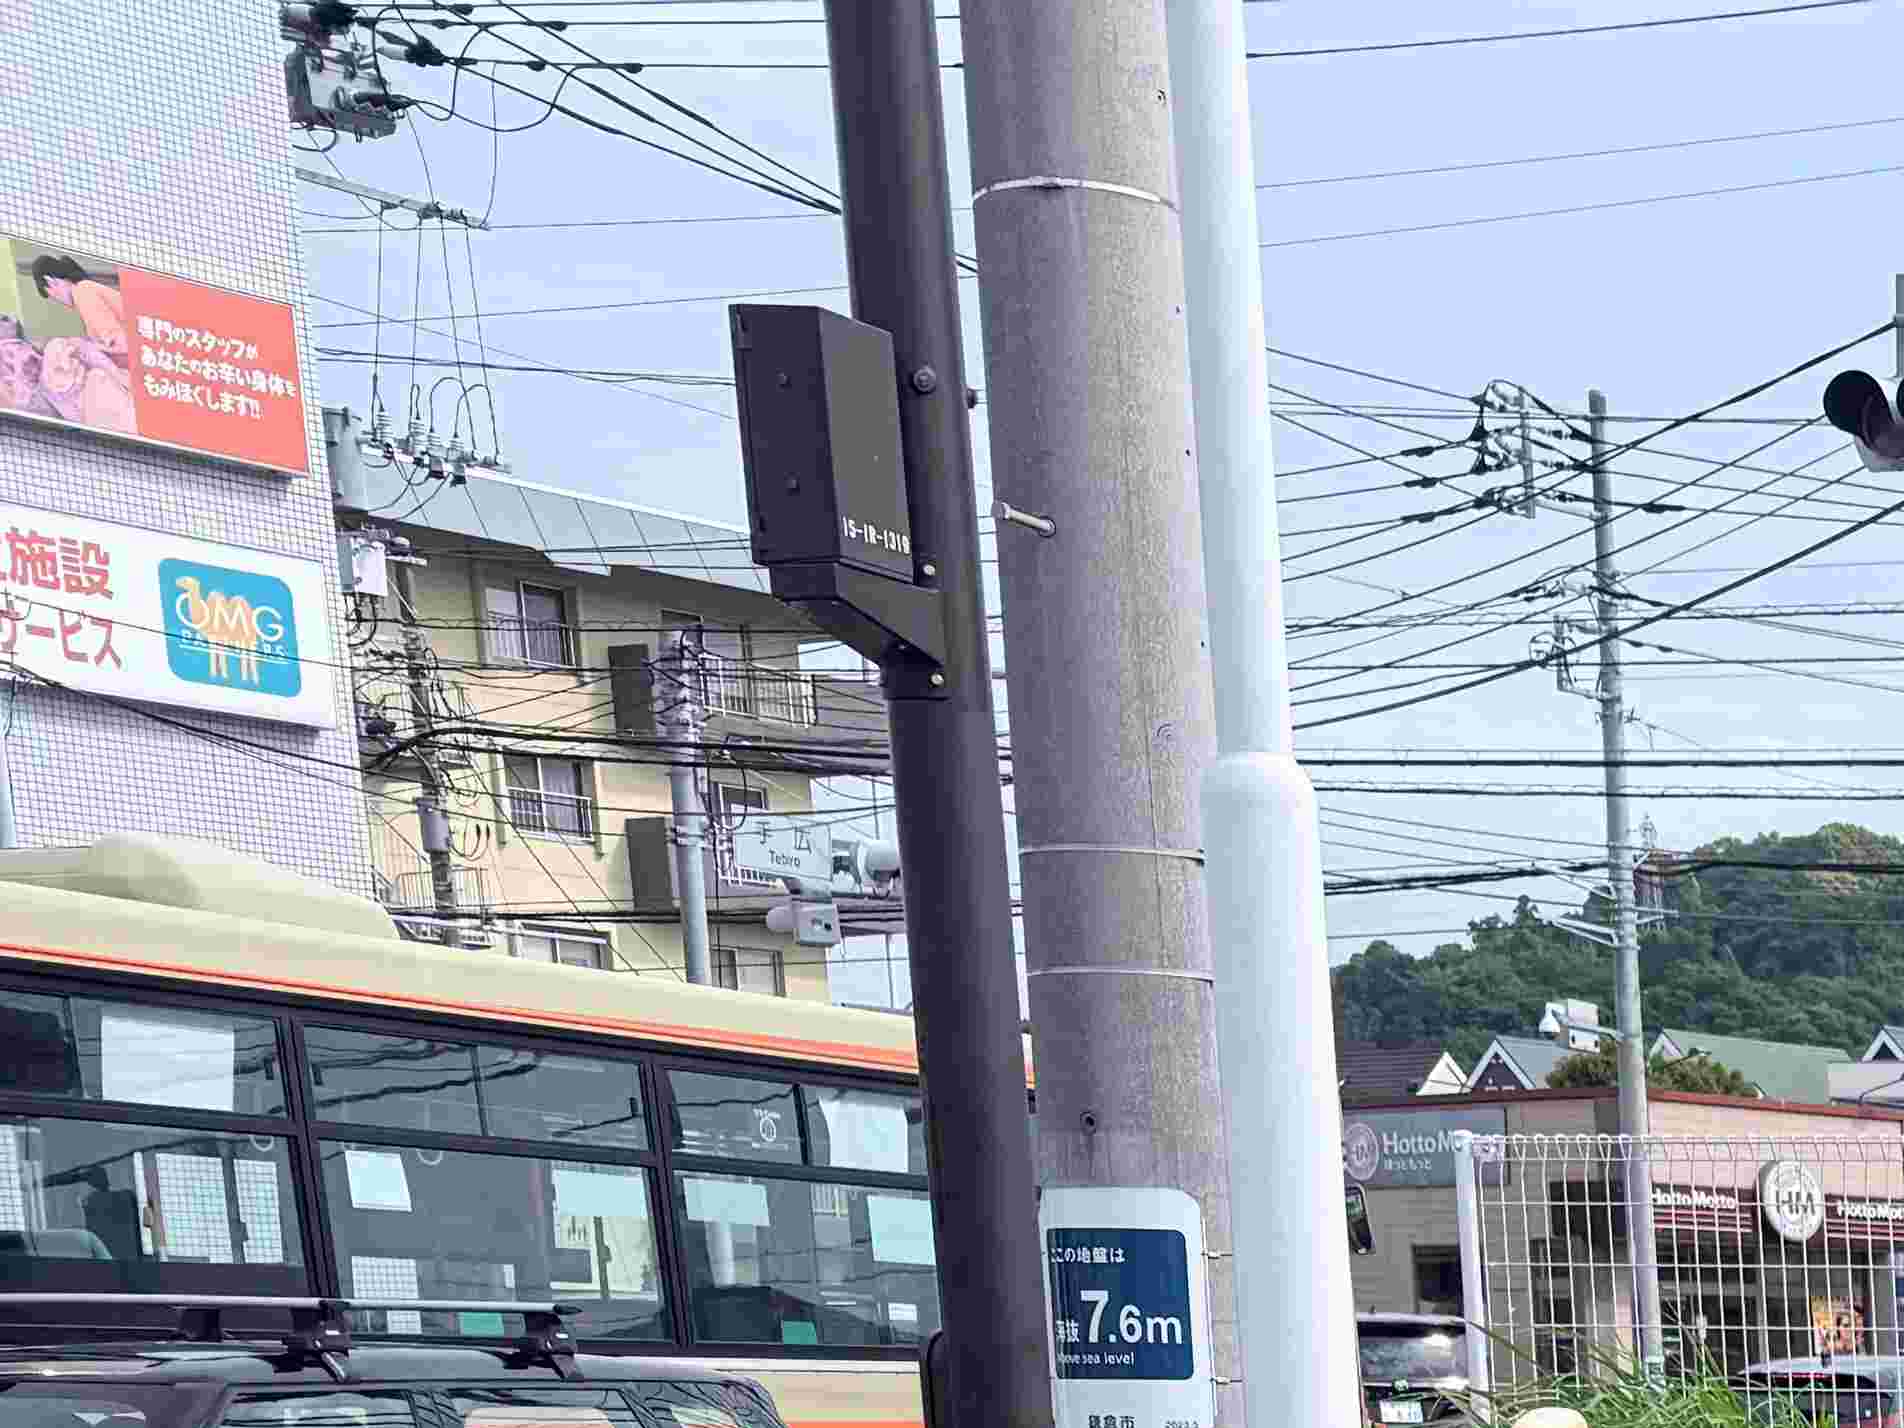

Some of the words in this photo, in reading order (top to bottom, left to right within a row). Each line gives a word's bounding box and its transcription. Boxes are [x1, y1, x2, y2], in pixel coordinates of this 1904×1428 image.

[0, 526, 114, 601] 施設
[1080, 1289, 1183, 1345] 7.6m
[1103, 1351, 1135, 1365] level
